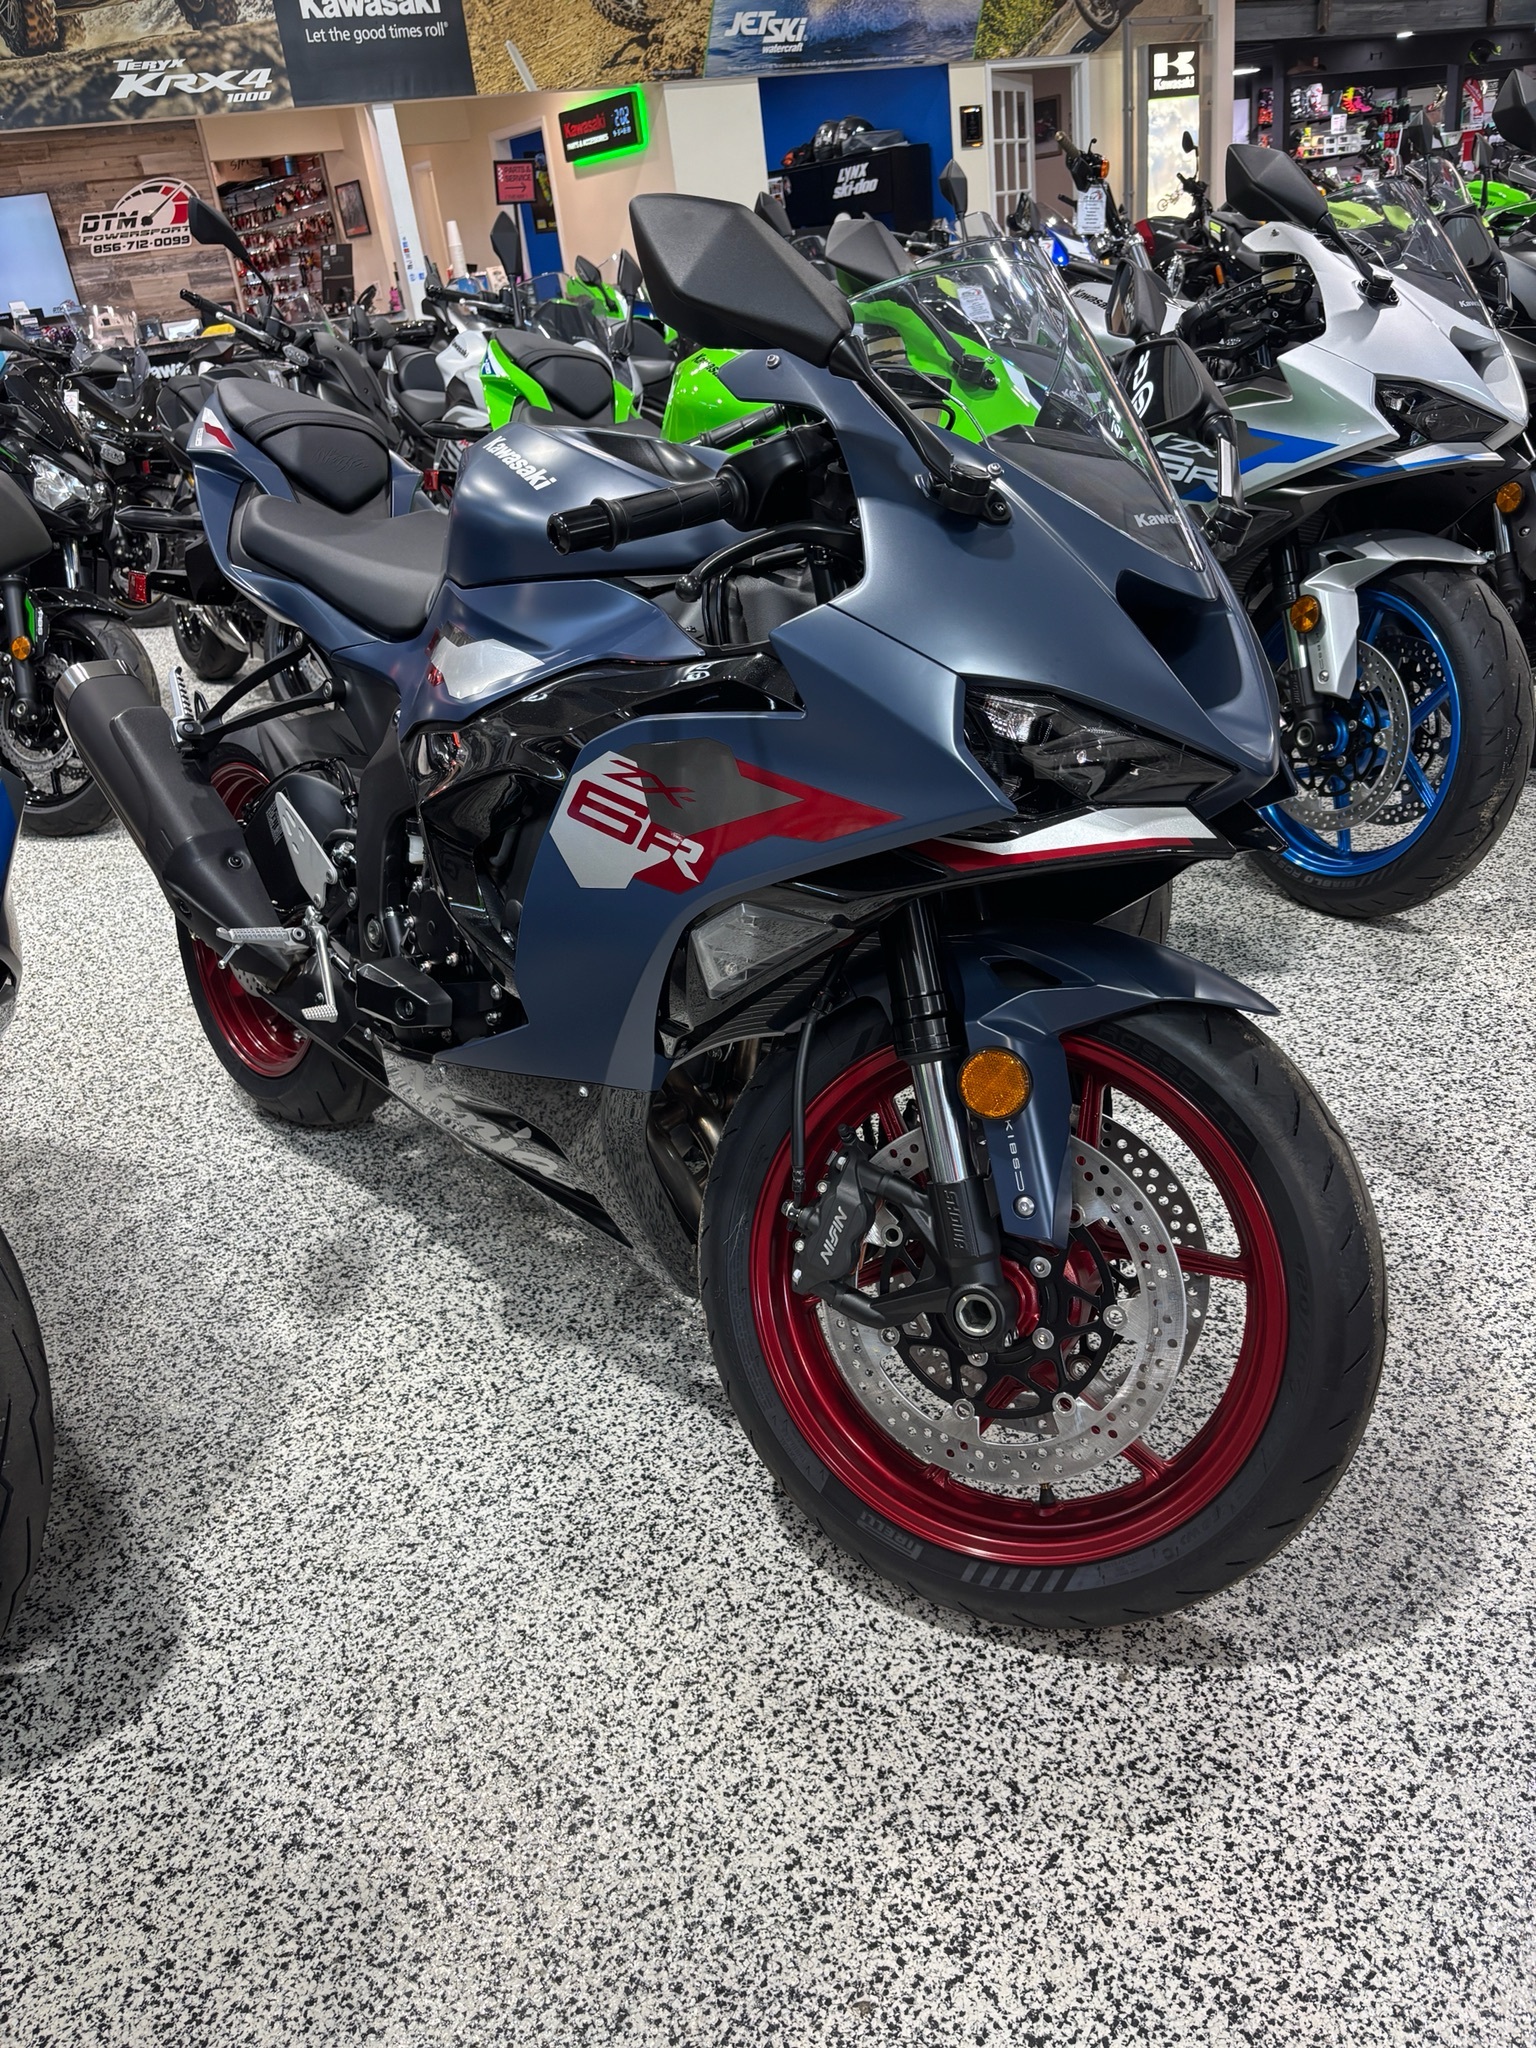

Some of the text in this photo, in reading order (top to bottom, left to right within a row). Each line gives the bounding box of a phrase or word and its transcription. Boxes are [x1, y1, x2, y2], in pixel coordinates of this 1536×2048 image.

[300, 0, 441, 19] Kawasaki
[305, 28, 328, 43] Let
[328, 26, 351, 42] the
[353, 24, 387, 44] good
[388, 23, 423, 39] times
[762, 43, 804, 54] watercraft
[226, 91, 272, 104] 1000
[563, 113, 607, 139] Kawasaki
[504, 166, 525, 175] PARTS
[504, 174, 531, 183] SERVICE
[836, 162, 869, 184] LYNX
[82, 210, 139, 234] DTM
[482, 435, 558, 491] Kawasaki
[856, 1511, 924, 1560] PIRELLI
